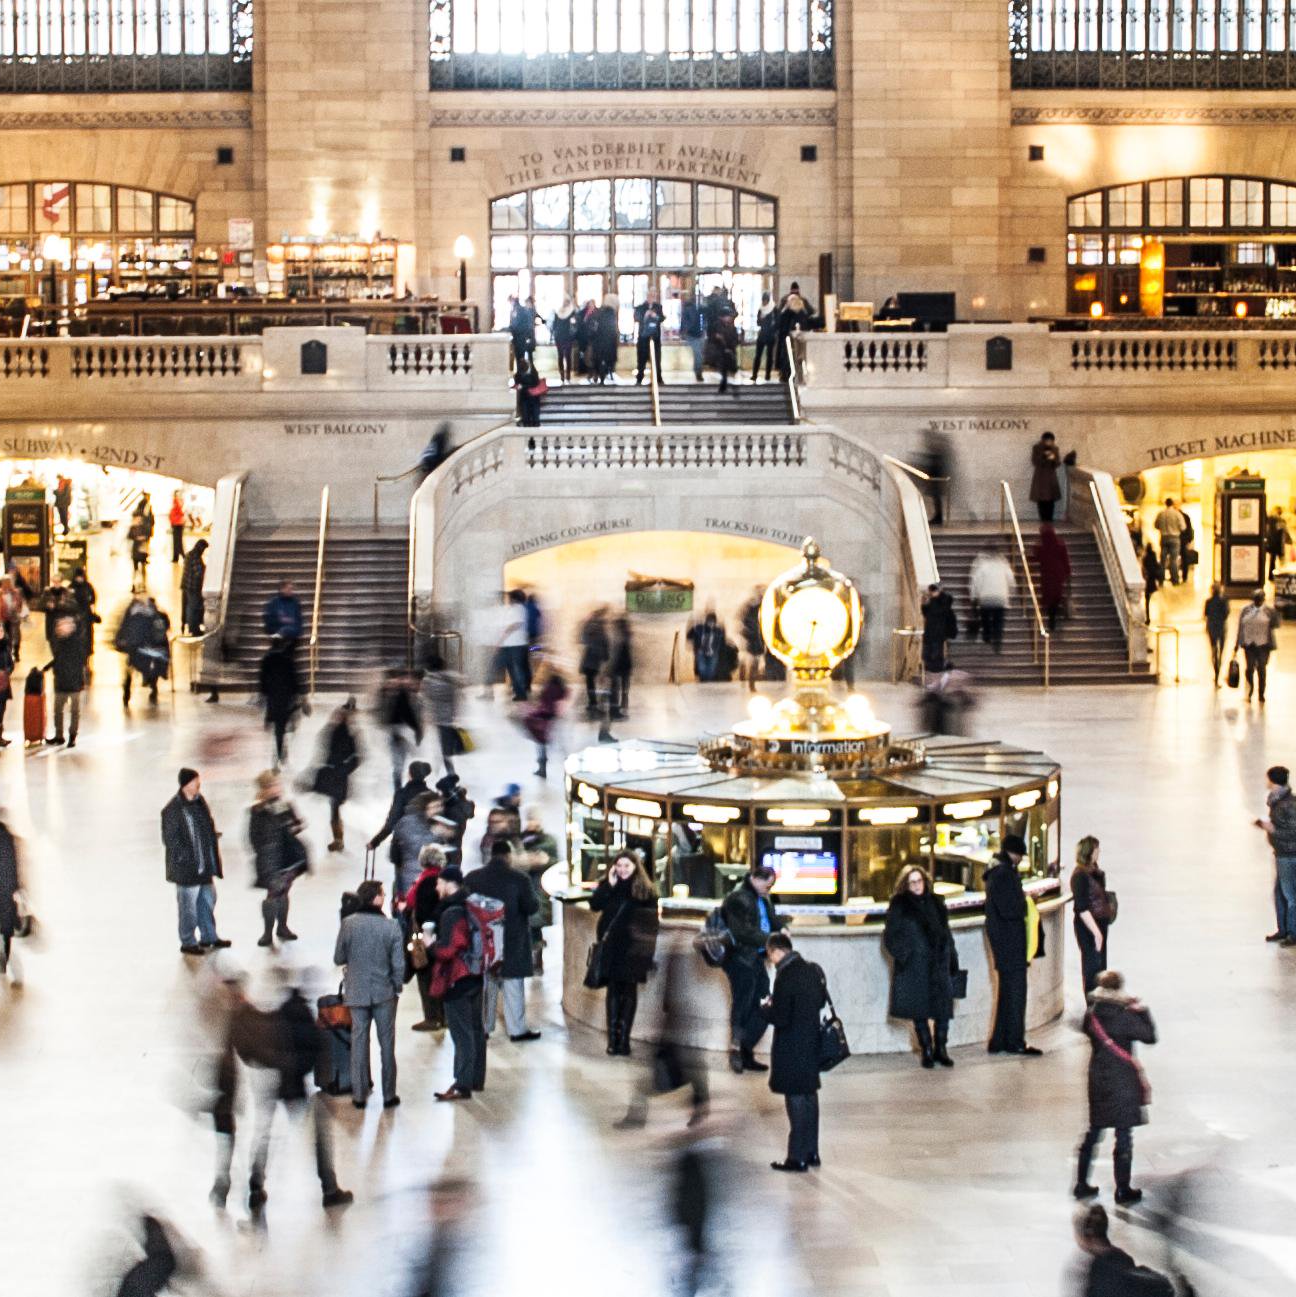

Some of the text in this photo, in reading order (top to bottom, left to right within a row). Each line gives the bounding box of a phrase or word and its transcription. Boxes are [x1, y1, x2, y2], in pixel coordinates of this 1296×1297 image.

[519, 142, 748, 166] TO VANDERBILT AVENUE
[505, 158, 762, 186] THE CAMPBELL APARTMENT
[283, 423, 388, 435] WEST BALCONY
[929, 419, 1031, 431] WEST BALCONY
[4, 438, 165, 469] SUBWAY 42ND ST
[1147, 439, 1208, 462] TICKET
[511, 518, 633, 553] DINING CONCOURSE
[704, 517, 749, 533] TRACKS
[771, 528, 787, 540] TO
[791, 740, 865, 754] Information
